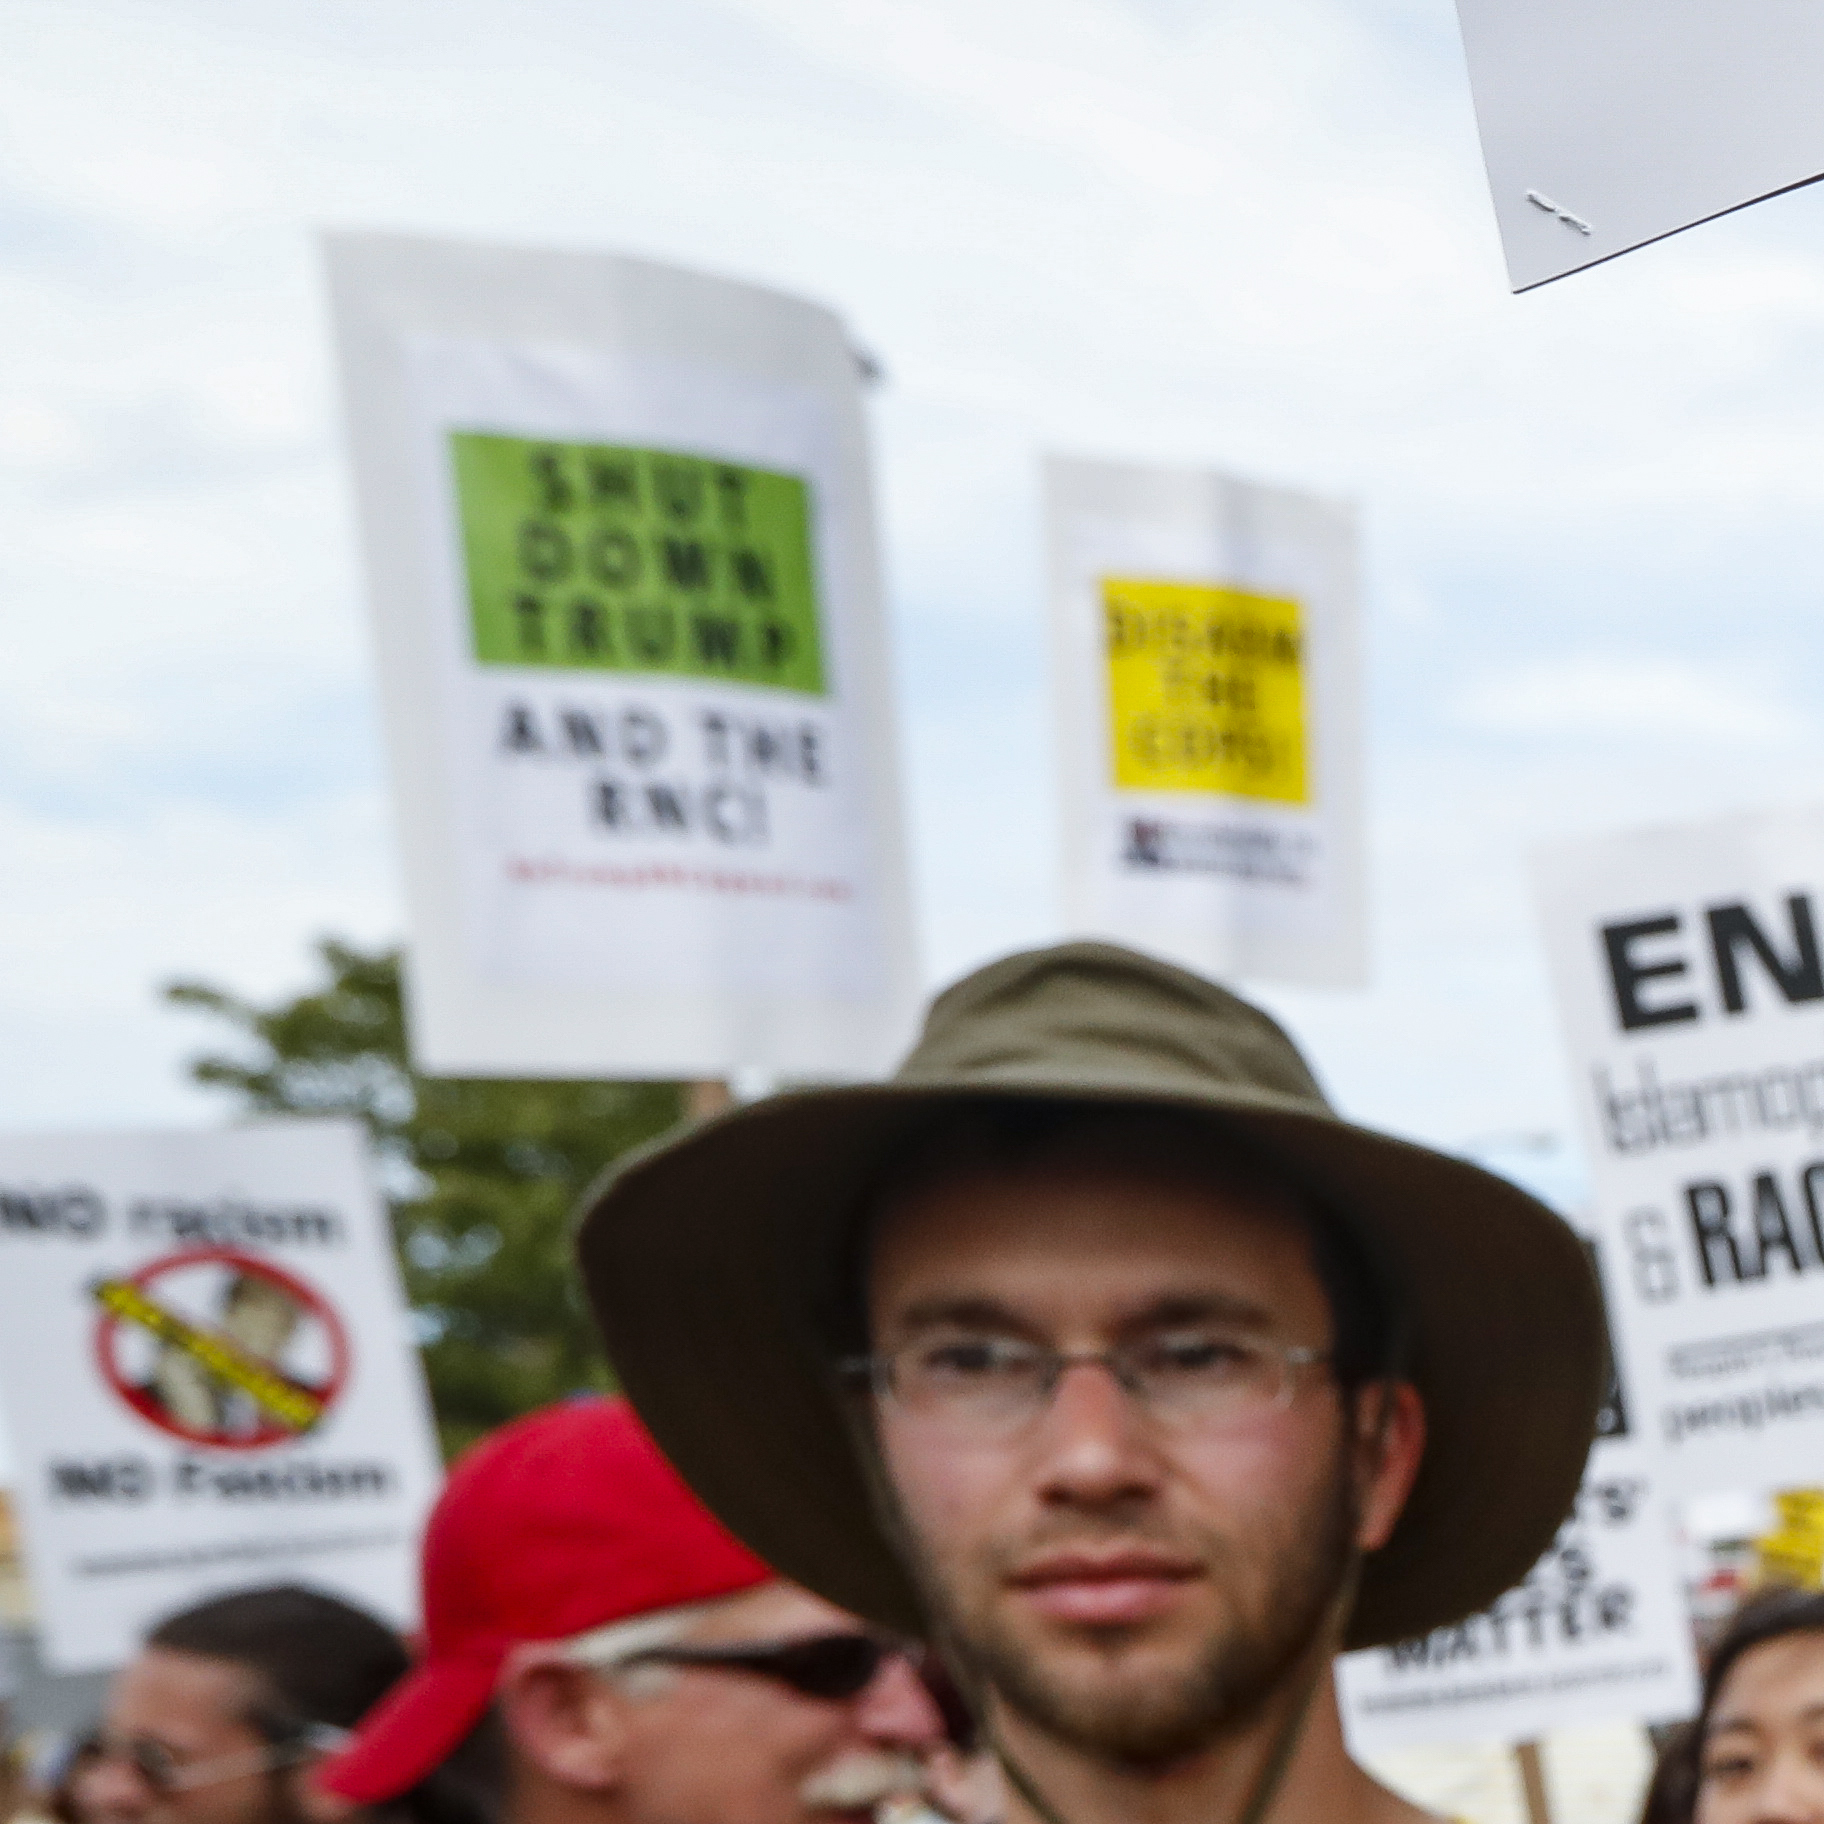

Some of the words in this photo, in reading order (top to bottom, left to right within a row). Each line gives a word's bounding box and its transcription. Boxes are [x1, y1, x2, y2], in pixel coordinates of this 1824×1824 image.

[529, 447, 748, 527] SHUT
[516, 517, 775, 602] DOWN
[510, 592, 798, 670] TRUMP
[500, 702, 670, 767] AND
[700, 709, 826, 788] THE
